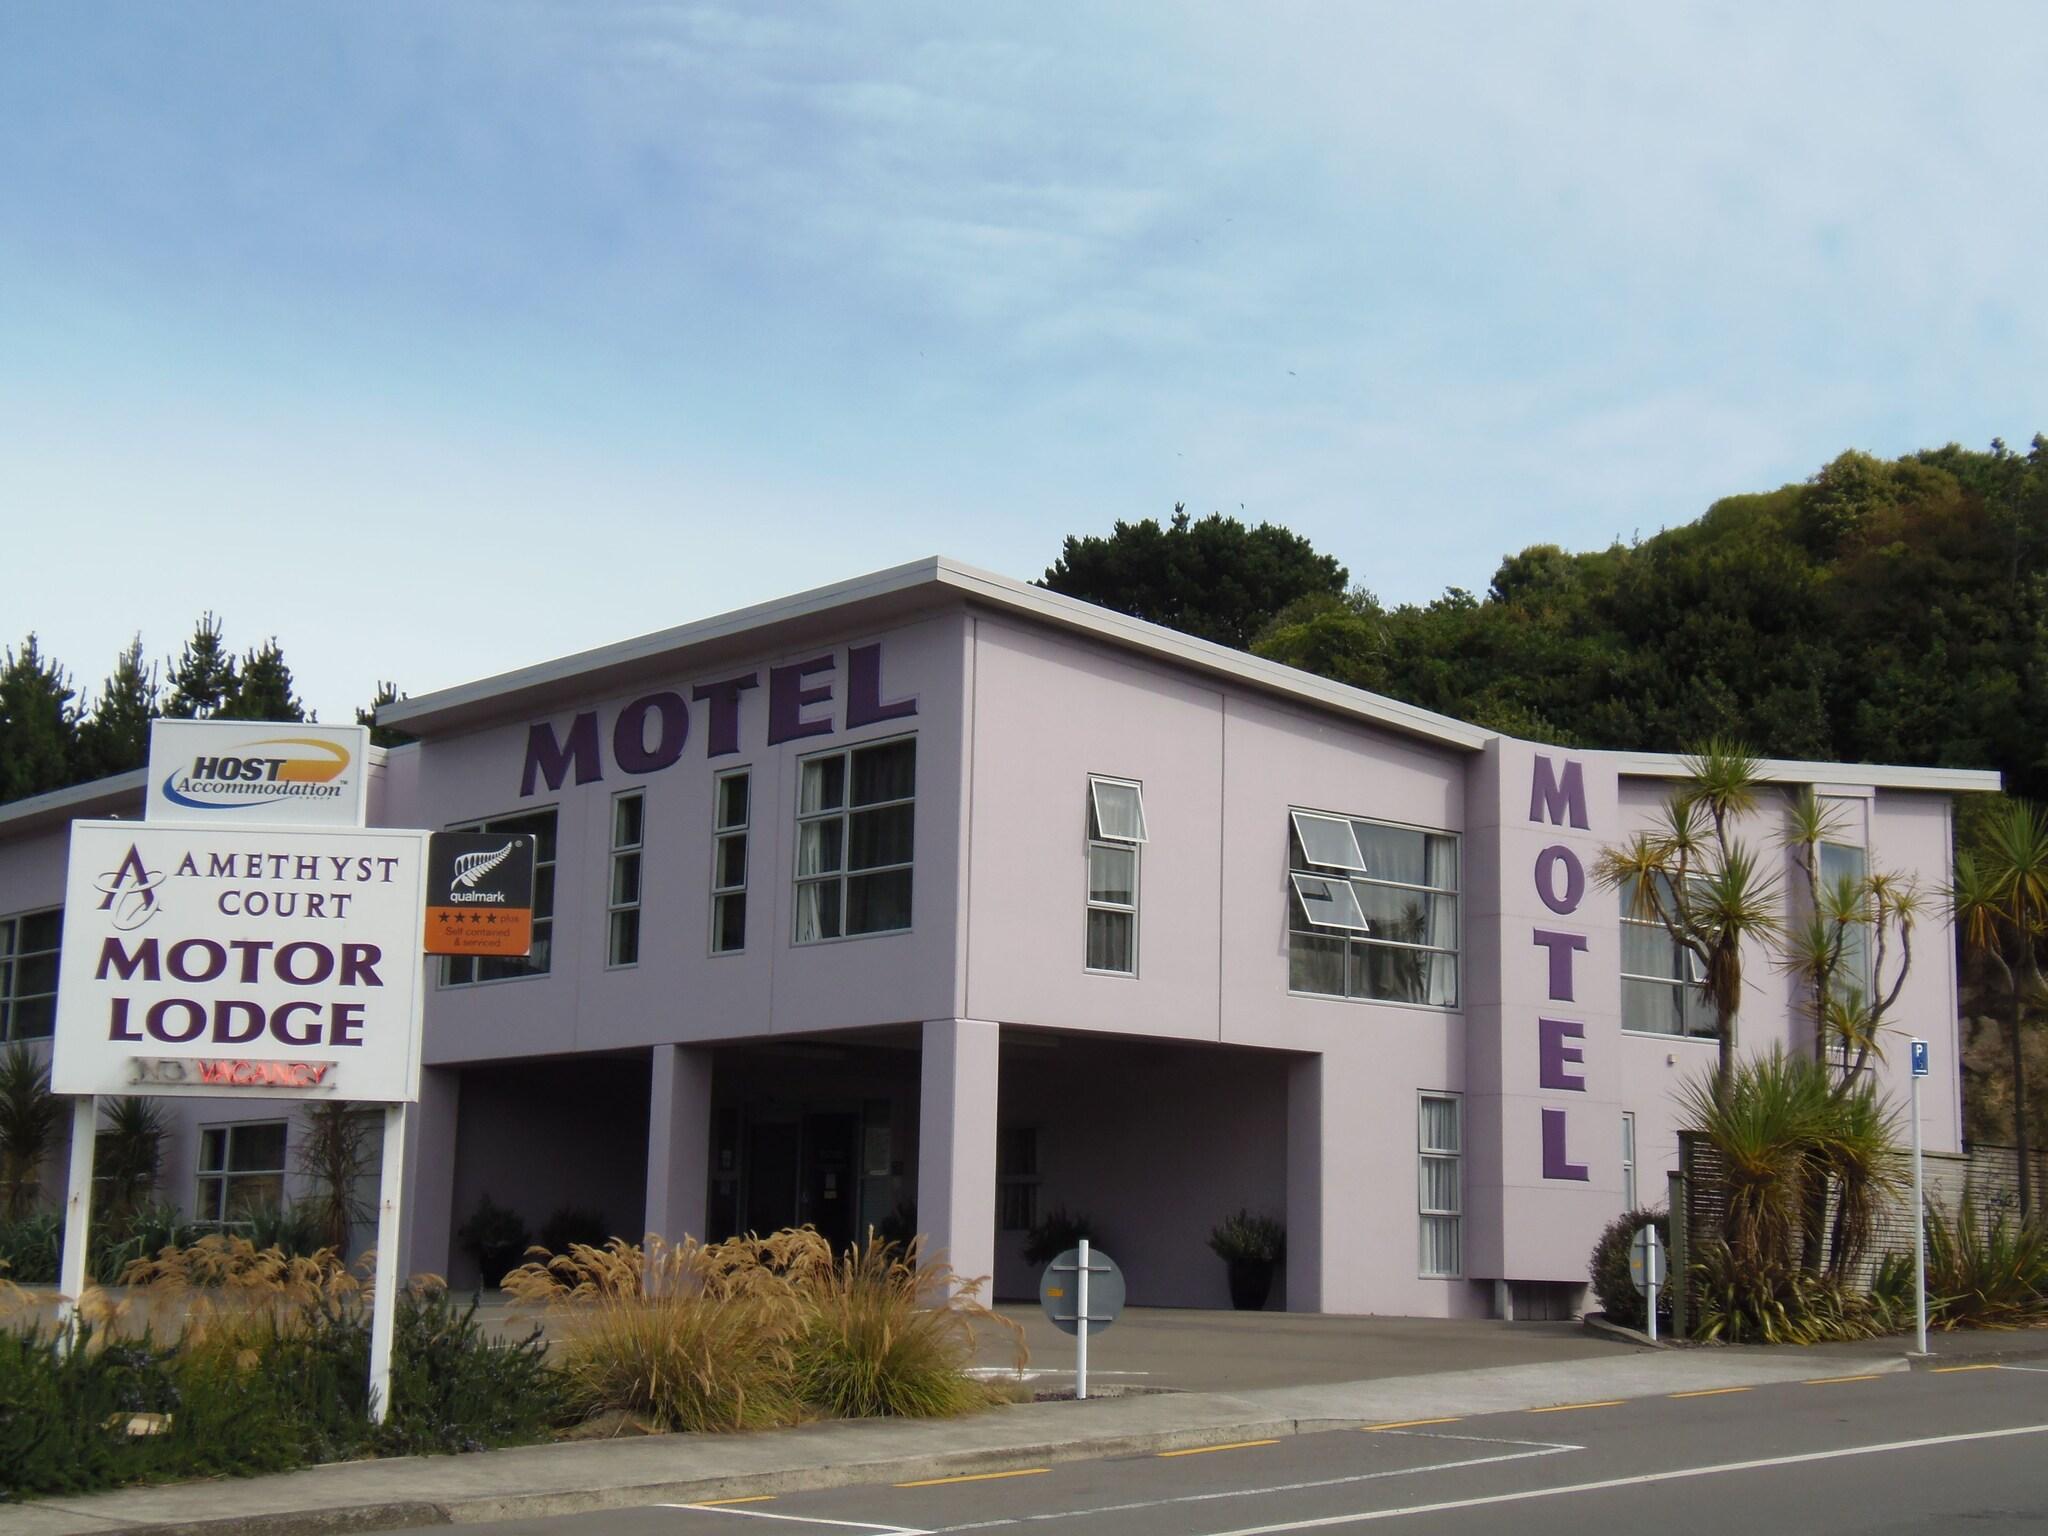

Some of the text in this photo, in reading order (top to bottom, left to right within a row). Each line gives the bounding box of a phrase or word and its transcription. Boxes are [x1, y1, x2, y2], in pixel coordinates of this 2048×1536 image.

[519, 642, 919, 798] MOTEL
[191, 756, 287, 782] HOST
[175, 777, 342, 797] Accommodation
[174, 850, 399, 883] AMETHYST
[218, 890, 352, 919] COURT
[450, 890, 505, 903] qualmark
[94, 937, 384, 987] MOTOR
[1529, 752, 1590, 1182] MOTEL
[108, 998, 366, 1047] LODGE
[1915, 1044, 1923, 1057] P
[198, 1059, 328, 1086] VACANCY
